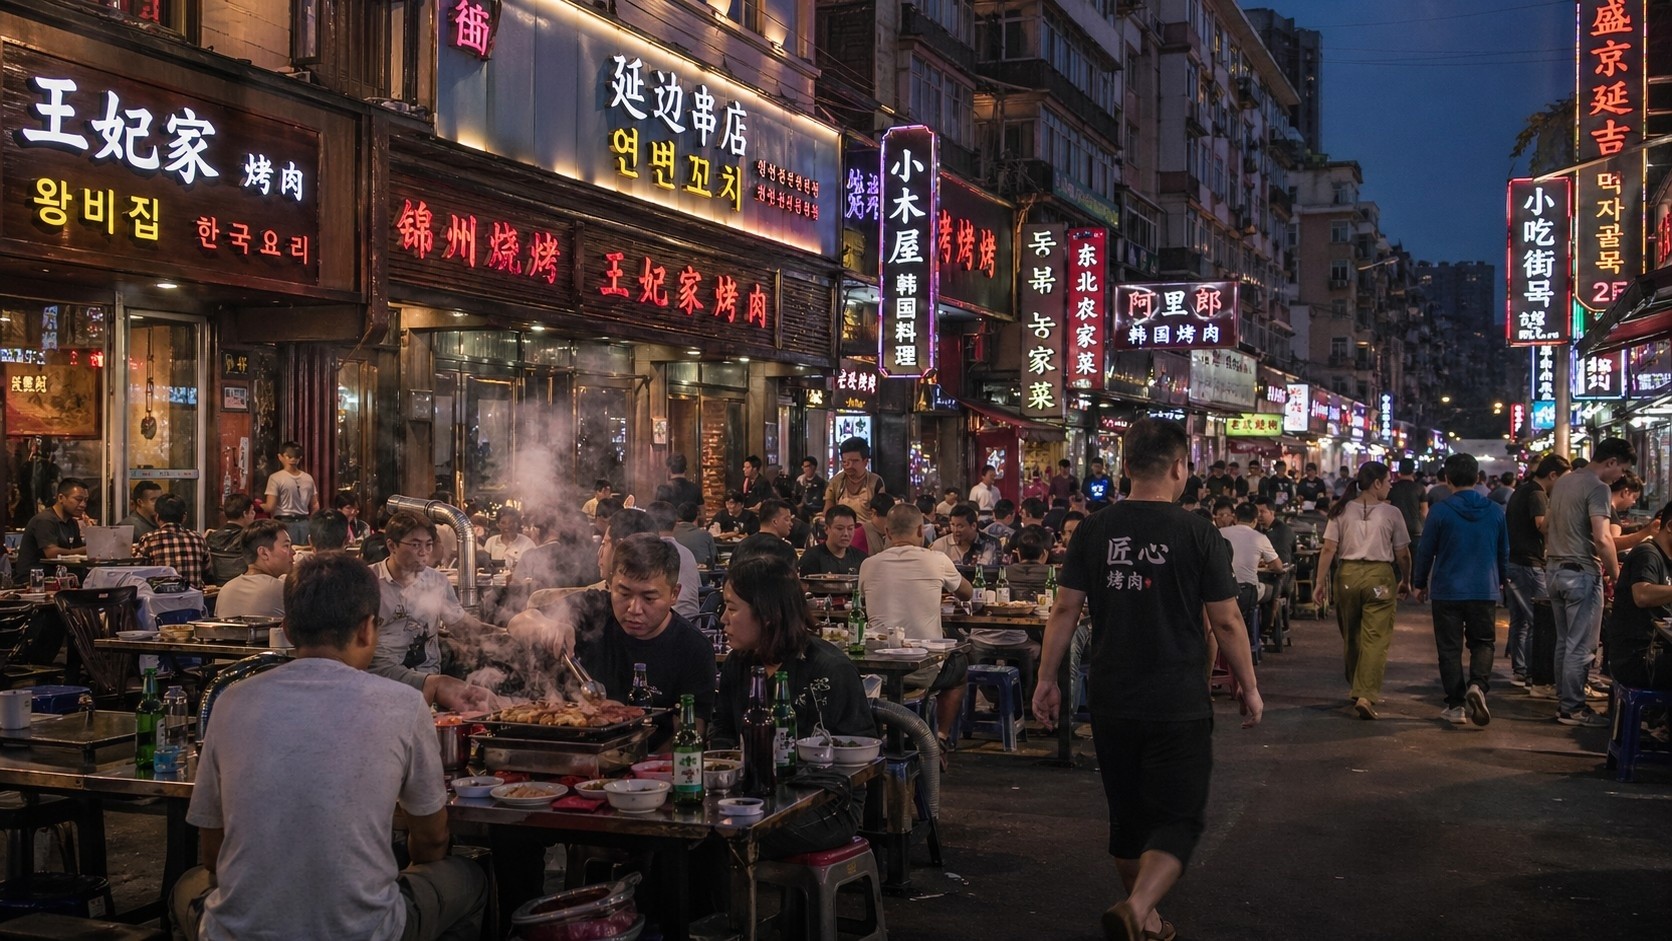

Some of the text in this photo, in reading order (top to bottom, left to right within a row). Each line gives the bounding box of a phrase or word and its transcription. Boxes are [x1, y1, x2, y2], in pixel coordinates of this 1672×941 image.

[611, 54, 748, 156] 延边串店
[1588, 0, 1633, 156] 盛京延吉
[22, 76, 220, 184] 王妃家
[613, 127, 742, 213] 연변꼬치
[33, 177, 160, 241] 왕비집
[243, 153, 304, 202] 烤肉
[887, 149, 926, 264] 小木屋
[196, 216, 309, 265] 한국요리
[396, 199, 561, 285] 锦州烧烤
[1595, 172, 1626, 275] 먹자골목
[599, 252, 768, 329] 王妃家烤肉
[894, 273, 917, 366] 韩国料理
[1075, 243, 1098, 375] 东北农家菜
[1128, 288, 1222, 317] 阿里郎
[1592, 281, 1628, 303] 2F
[1127, 322, 1220, 345] 韩国烤肉
[1106, 536, 1169, 566] 匠心
[1106, 569, 1143, 591] 烤肉
